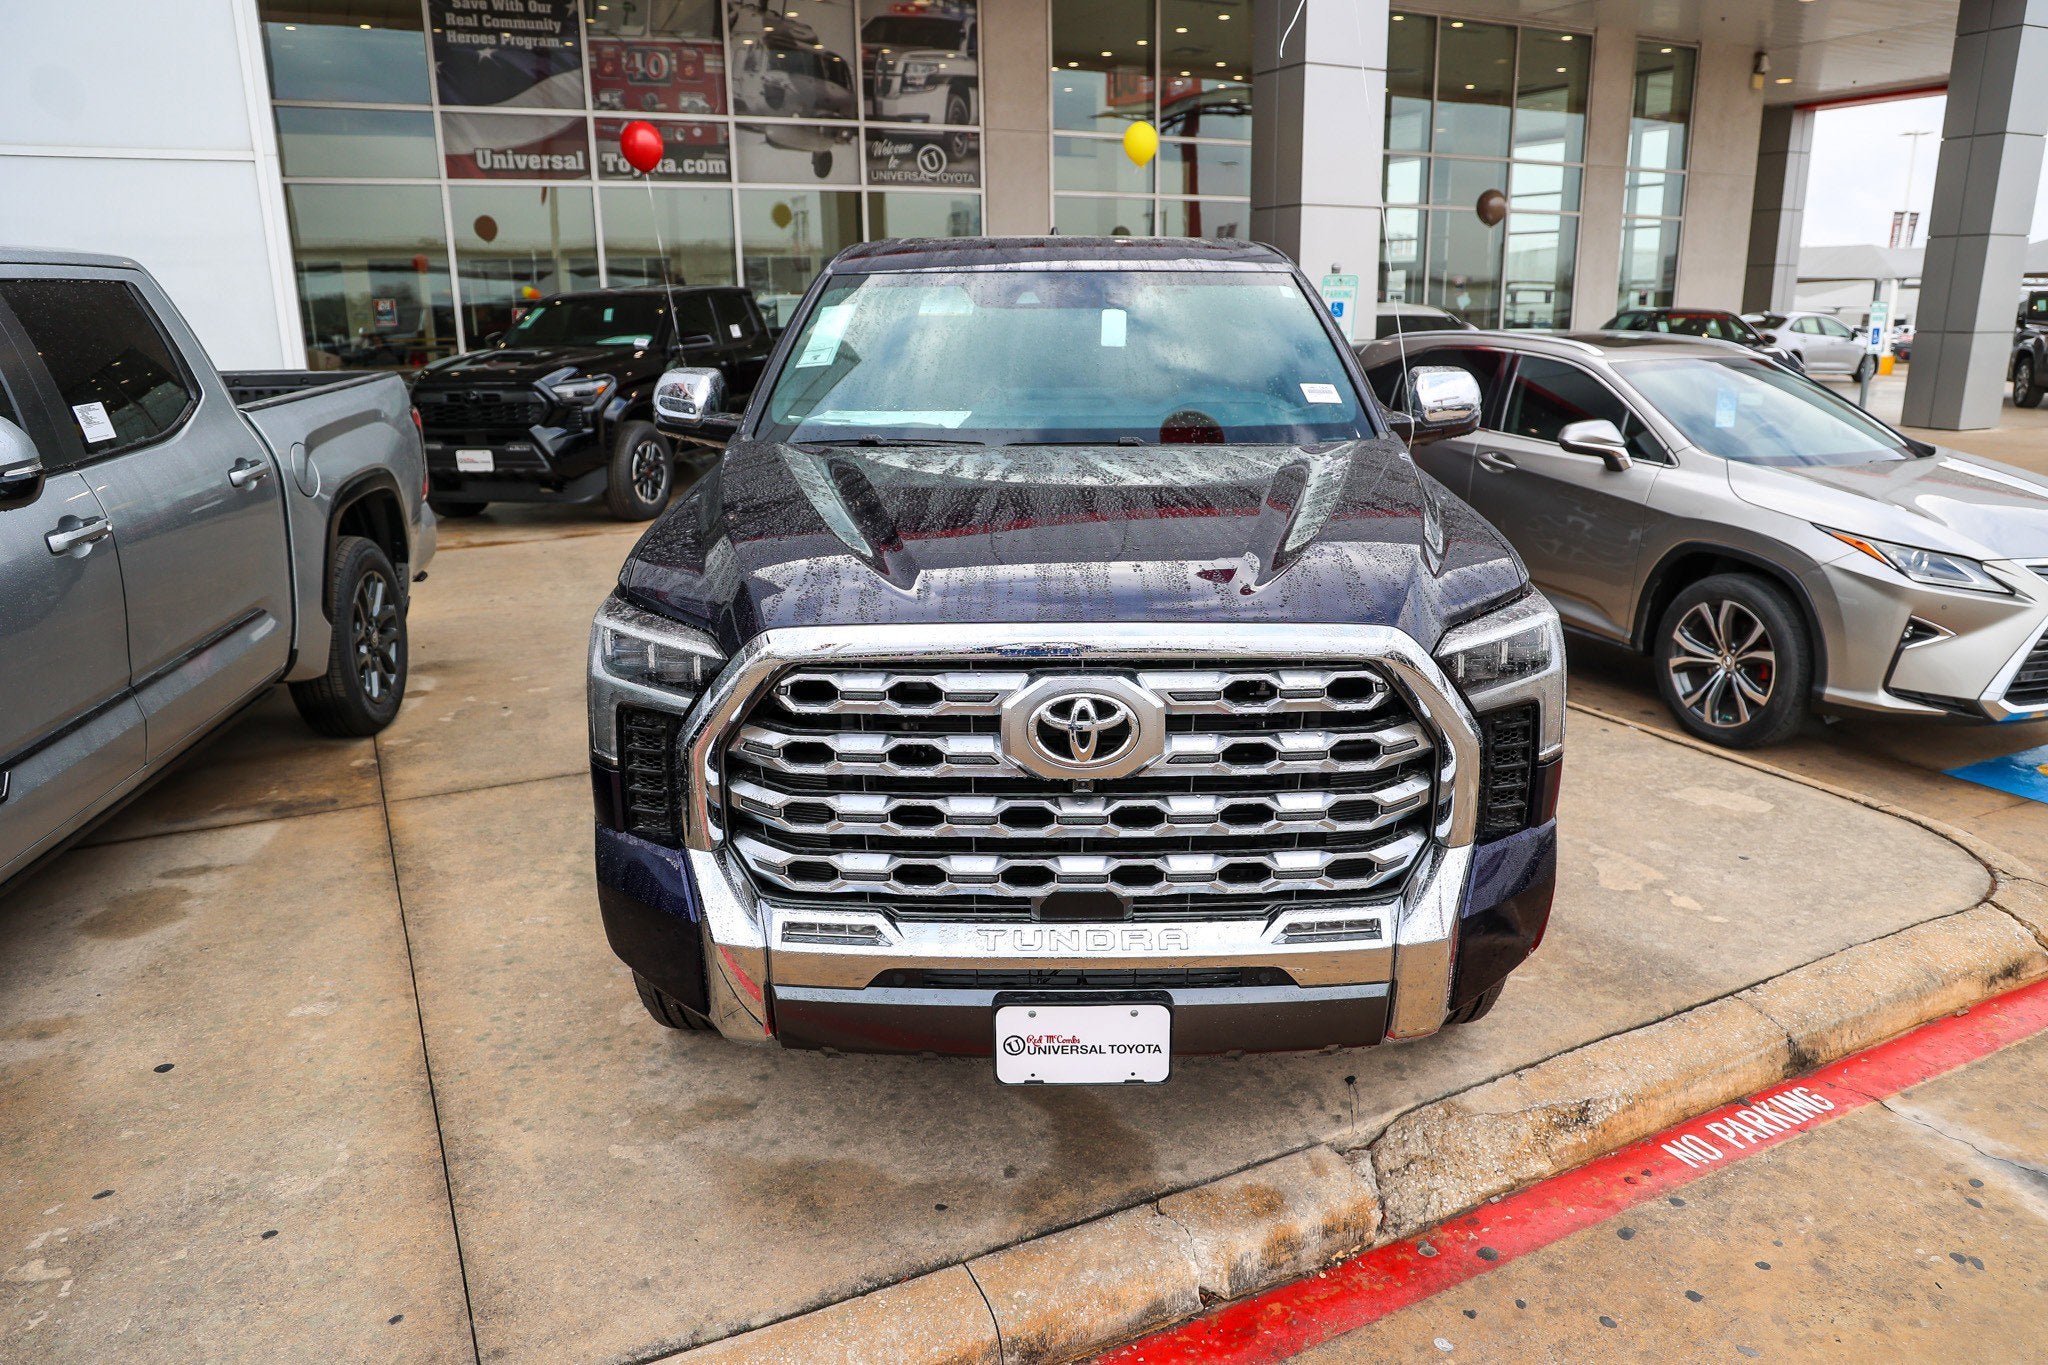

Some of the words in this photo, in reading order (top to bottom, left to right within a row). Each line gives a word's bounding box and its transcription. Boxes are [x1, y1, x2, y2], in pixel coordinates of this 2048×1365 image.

[452, 0, 487, 10] Save
[492, 0, 524, 12] With
[528, 0, 552, 13] Our
[445, 12, 478, 27] Real
[482, 14, 561, 33] Community
[446, 30, 496, 44] Heroes
[501, 34, 563, 49] Program.
[625, 52, 669, 80] 40
[872, 139, 914, 157] Welcome
[475, 149, 586, 171] Universal
[888, 155, 900, 170] to
[871, 170, 931, 181] UNIVERSAL
[934, 172, 975, 183] TOYOTA
[977, 928, 1190, 952] TUNDRA
[1026, 1035, 1043, 1047] Red
[1046, 1035, 1081, 1045] McCombs
[1027, 1044, 1106, 1056] UNIVERSAL
[1109, 1044, 1162, 1054] TOYOTA
[1661, 1134, 1724, 1169] NO
[1705, 1086, 1835, 1150] PARKING
